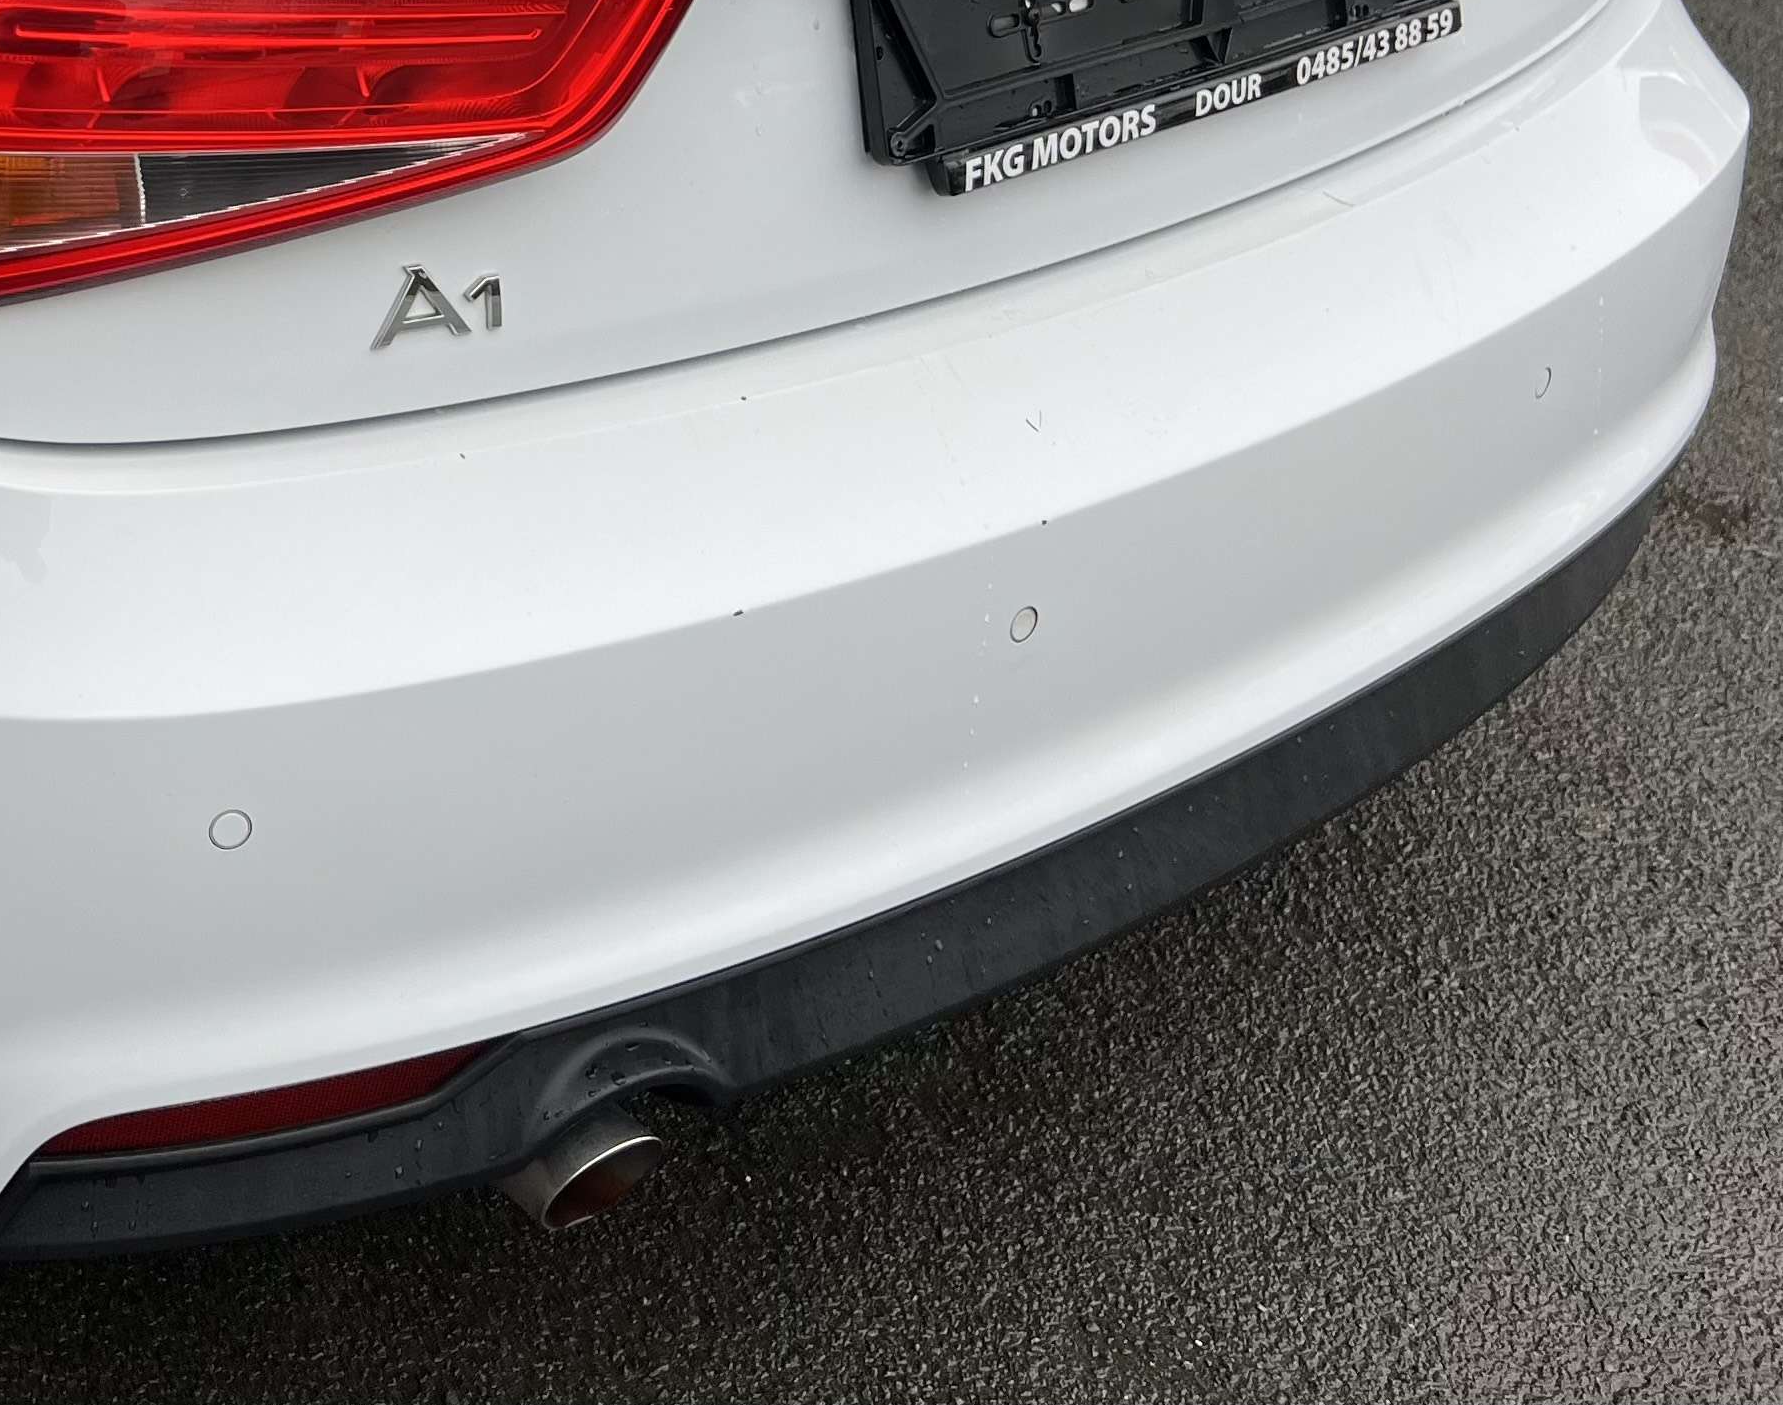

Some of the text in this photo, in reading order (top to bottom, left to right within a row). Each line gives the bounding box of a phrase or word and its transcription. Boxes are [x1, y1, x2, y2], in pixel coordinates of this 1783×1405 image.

[965, 8, 1454, 192] FKG MOTORS DOUR 0485/43 88 59
[370, 264, 503, 351] A1
